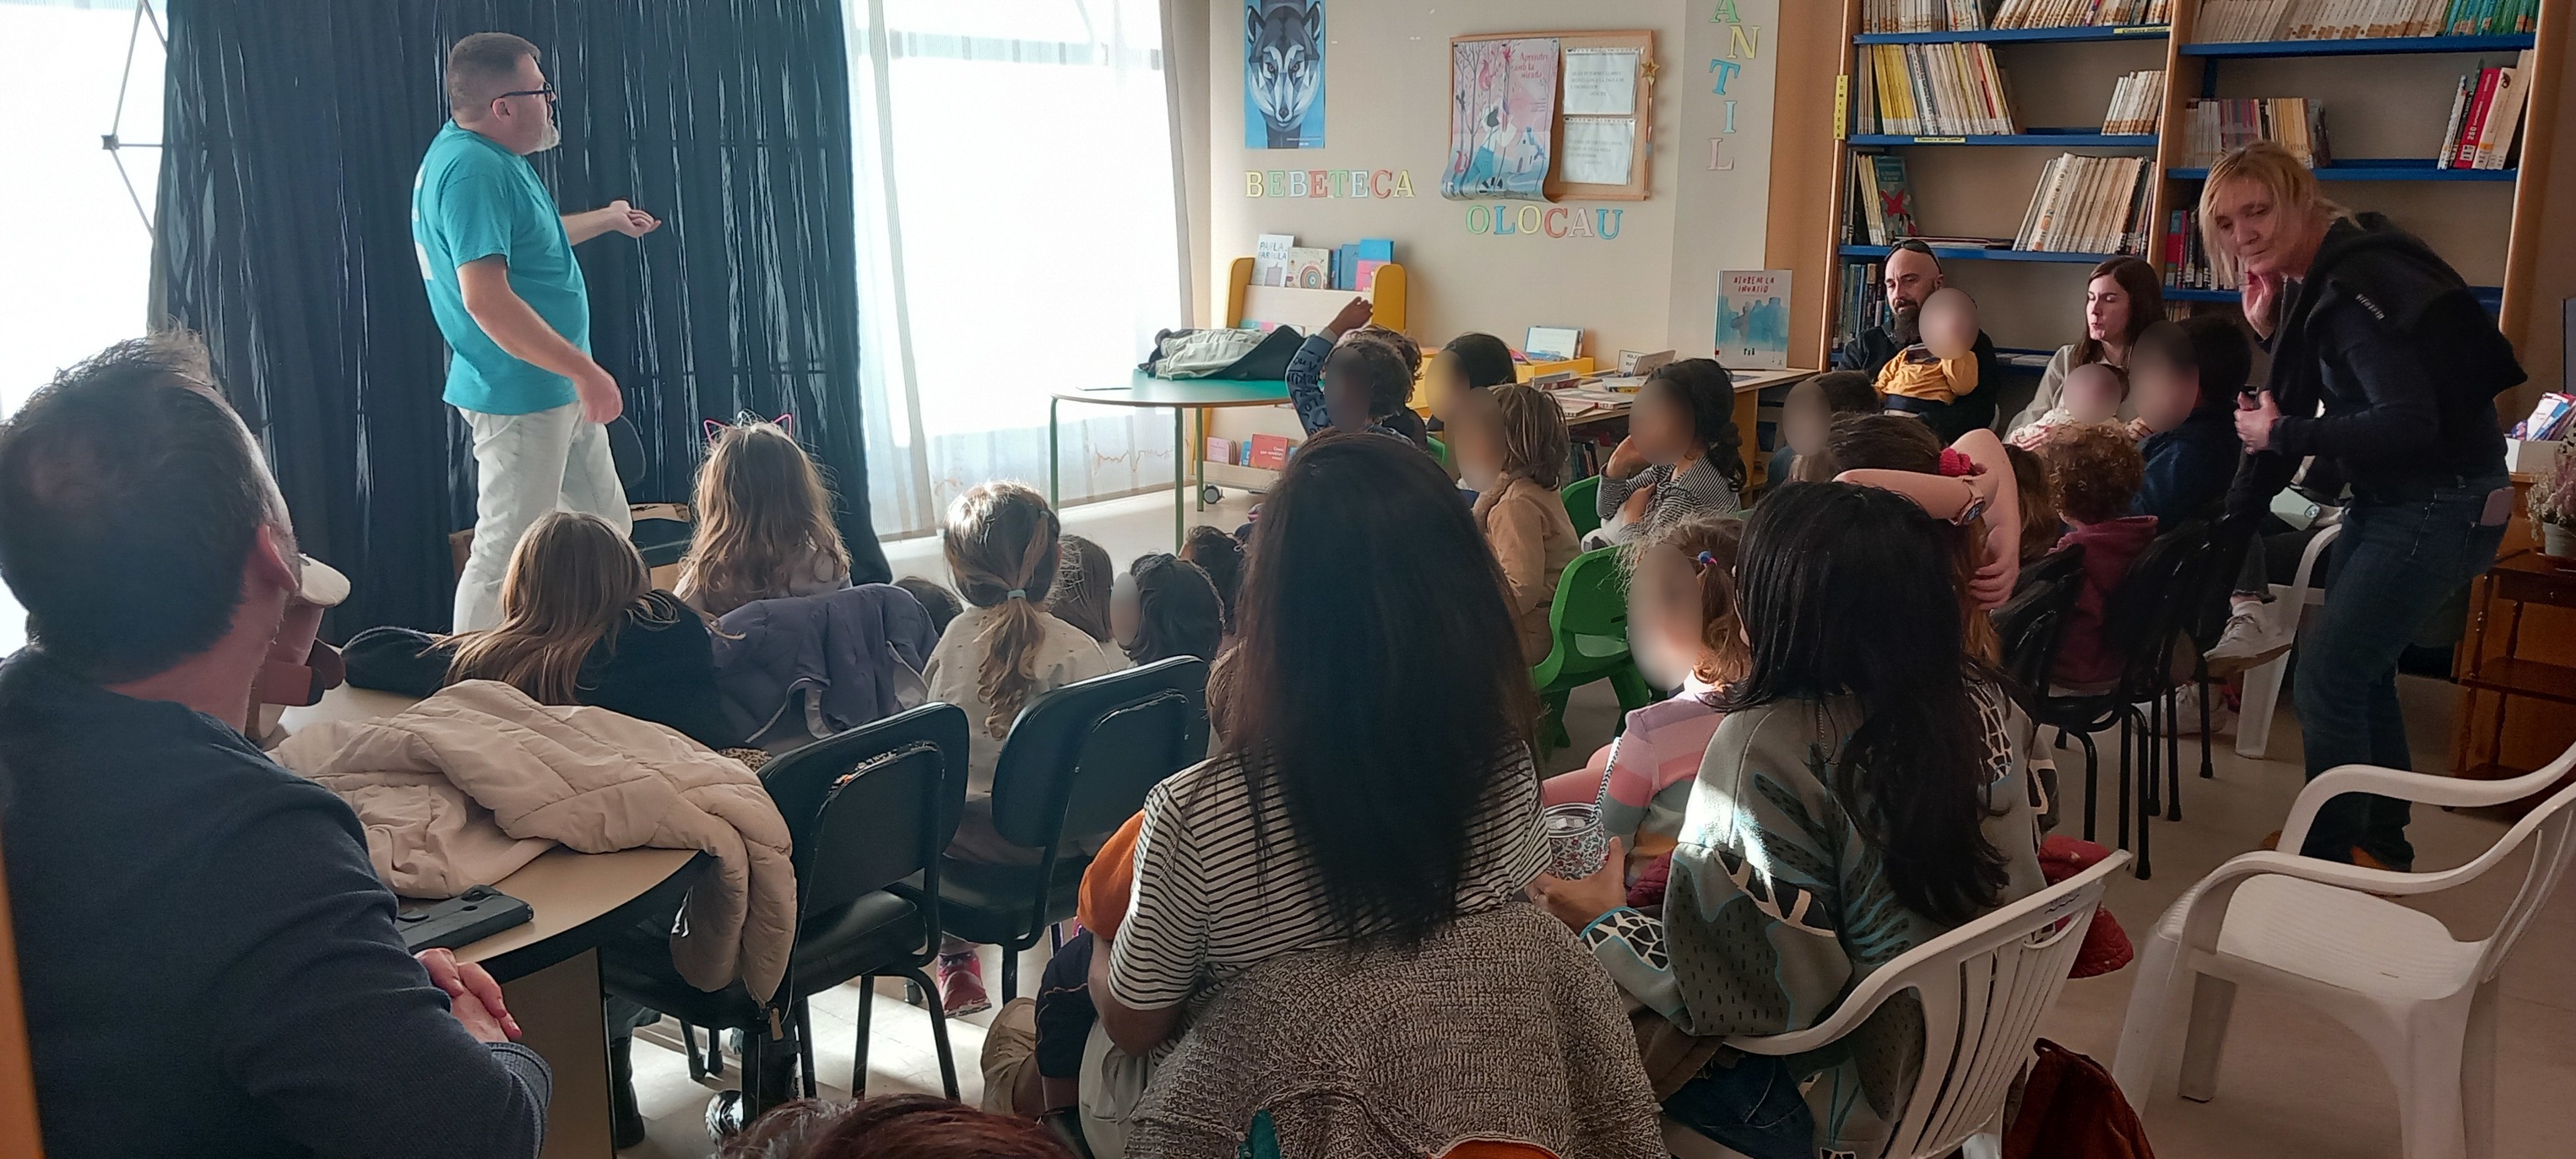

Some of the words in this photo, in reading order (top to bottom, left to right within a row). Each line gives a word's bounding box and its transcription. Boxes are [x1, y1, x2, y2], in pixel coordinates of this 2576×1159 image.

[1520, 51, 1548, 63] Aprendre
[1245, 170, 1416, 199] BEBETECA
[1466, 204, 1623, 240] OLOCAU
[1733, 276, 1764, 284] ATUREM
[1765, 276, 1775, 284] LA
